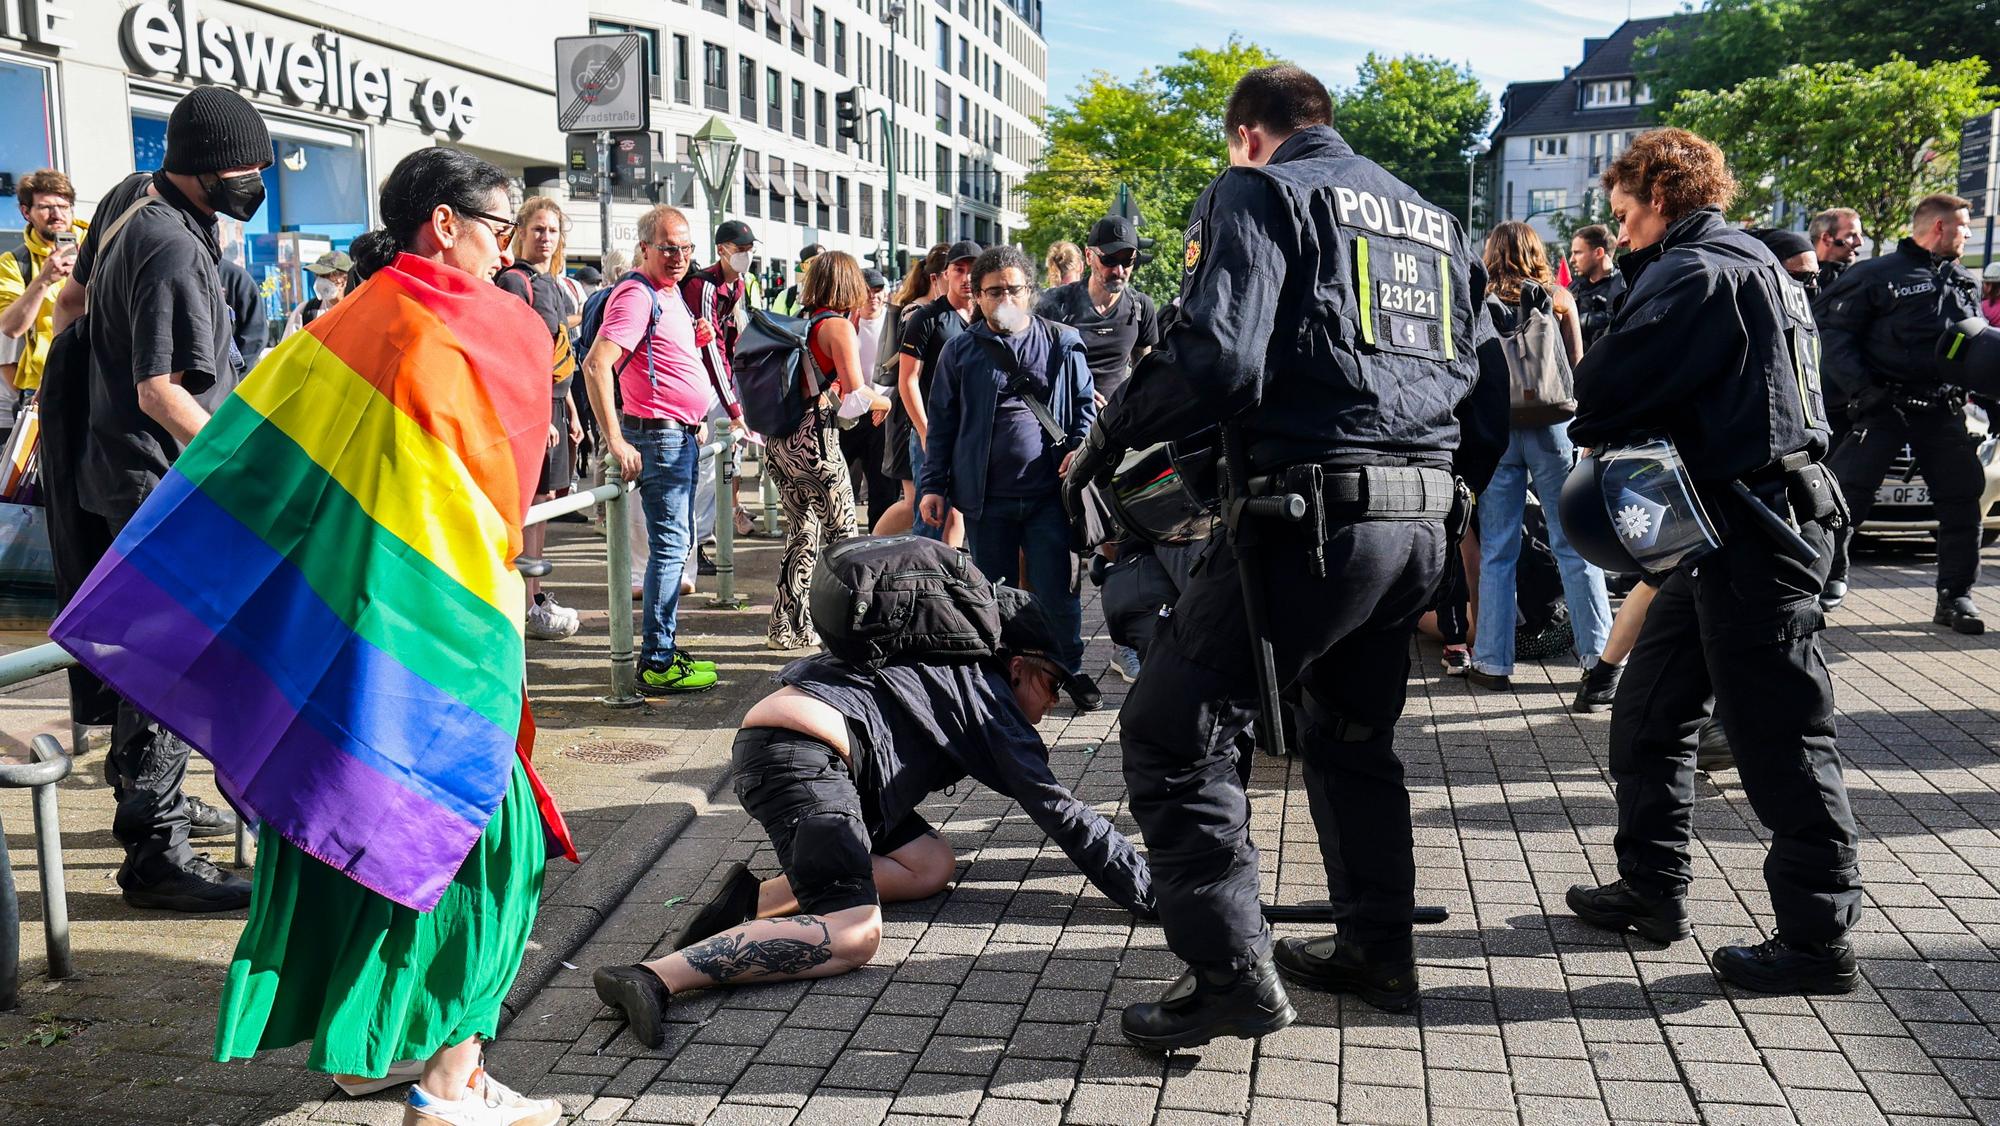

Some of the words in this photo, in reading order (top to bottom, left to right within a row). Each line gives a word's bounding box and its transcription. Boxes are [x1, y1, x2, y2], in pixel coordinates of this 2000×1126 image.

[569, 110, 636, 123] rradstraße
[1335, 187, 1450, 251] POLIZEI
[1393, 252, 1418, 284] HB
[1380, 283, 1436, 315] 23121
[1406, 324, 1416, 343] 5
[1894, 488, 1914, 503] QF
